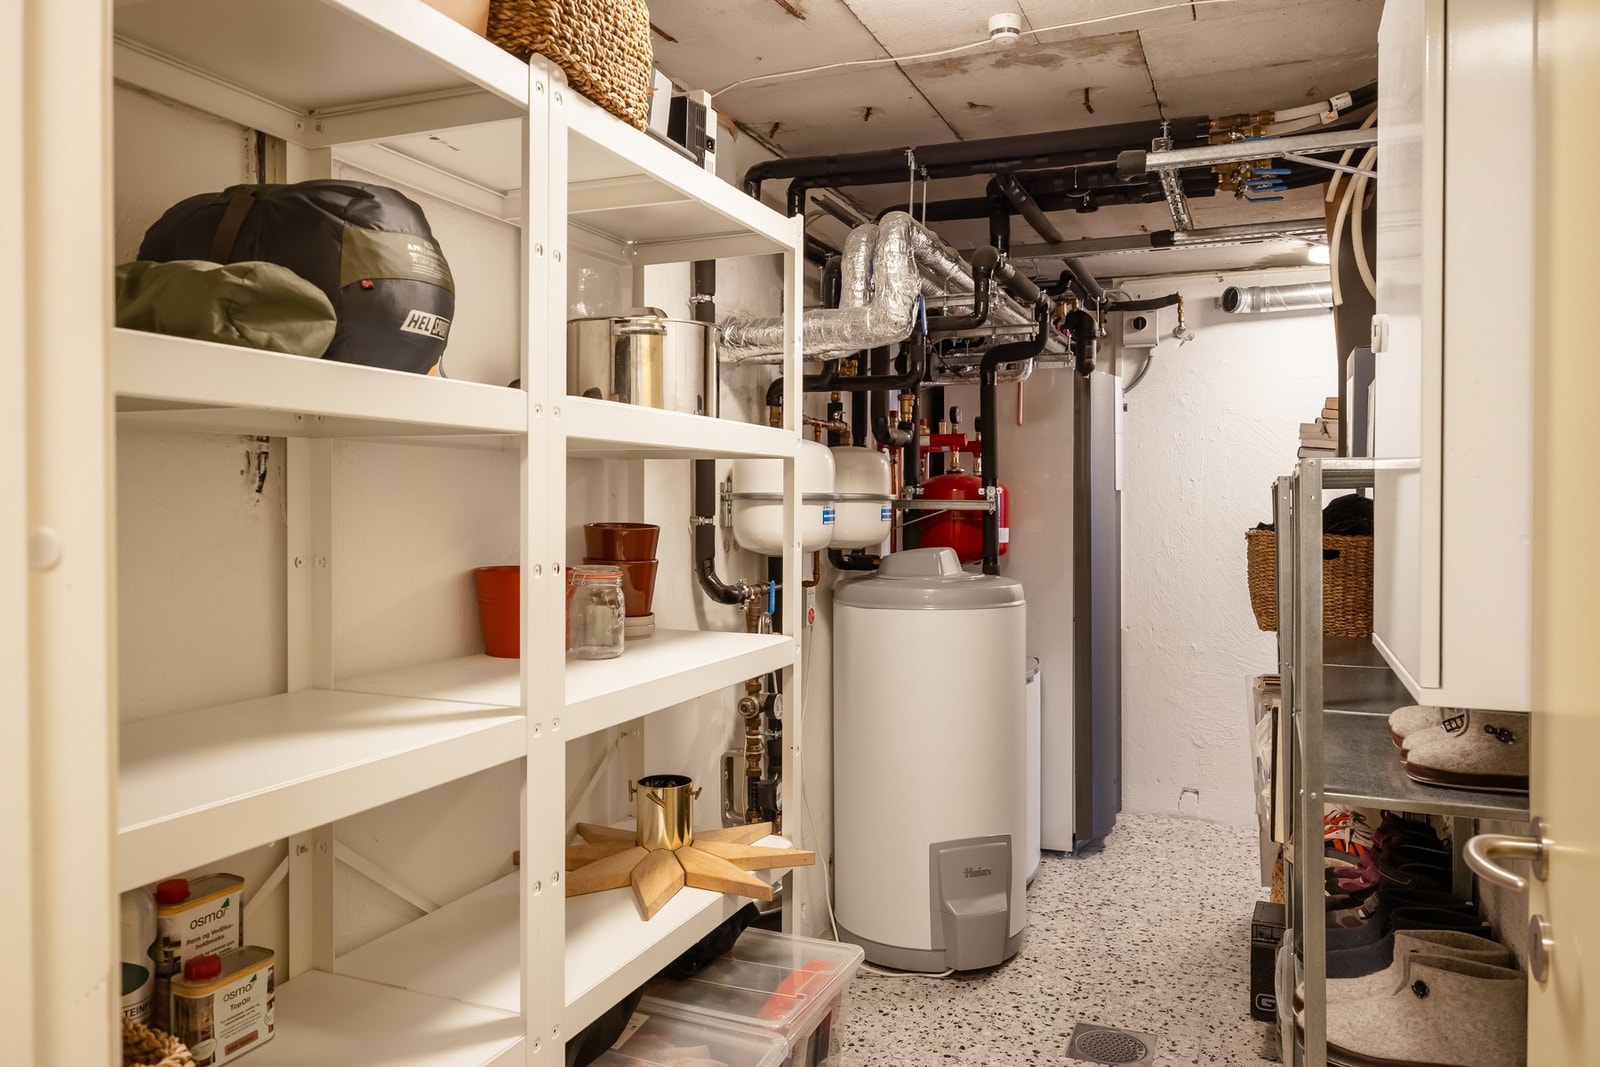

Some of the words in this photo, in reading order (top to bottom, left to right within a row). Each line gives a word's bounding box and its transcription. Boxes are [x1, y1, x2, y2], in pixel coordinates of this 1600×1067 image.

[407, 313, 431, 332] HEL
[190, 909, 224, 930] osmo
[223, 983, 253, 1003] osmo
[230, 997, 251, 1011] TopOil
